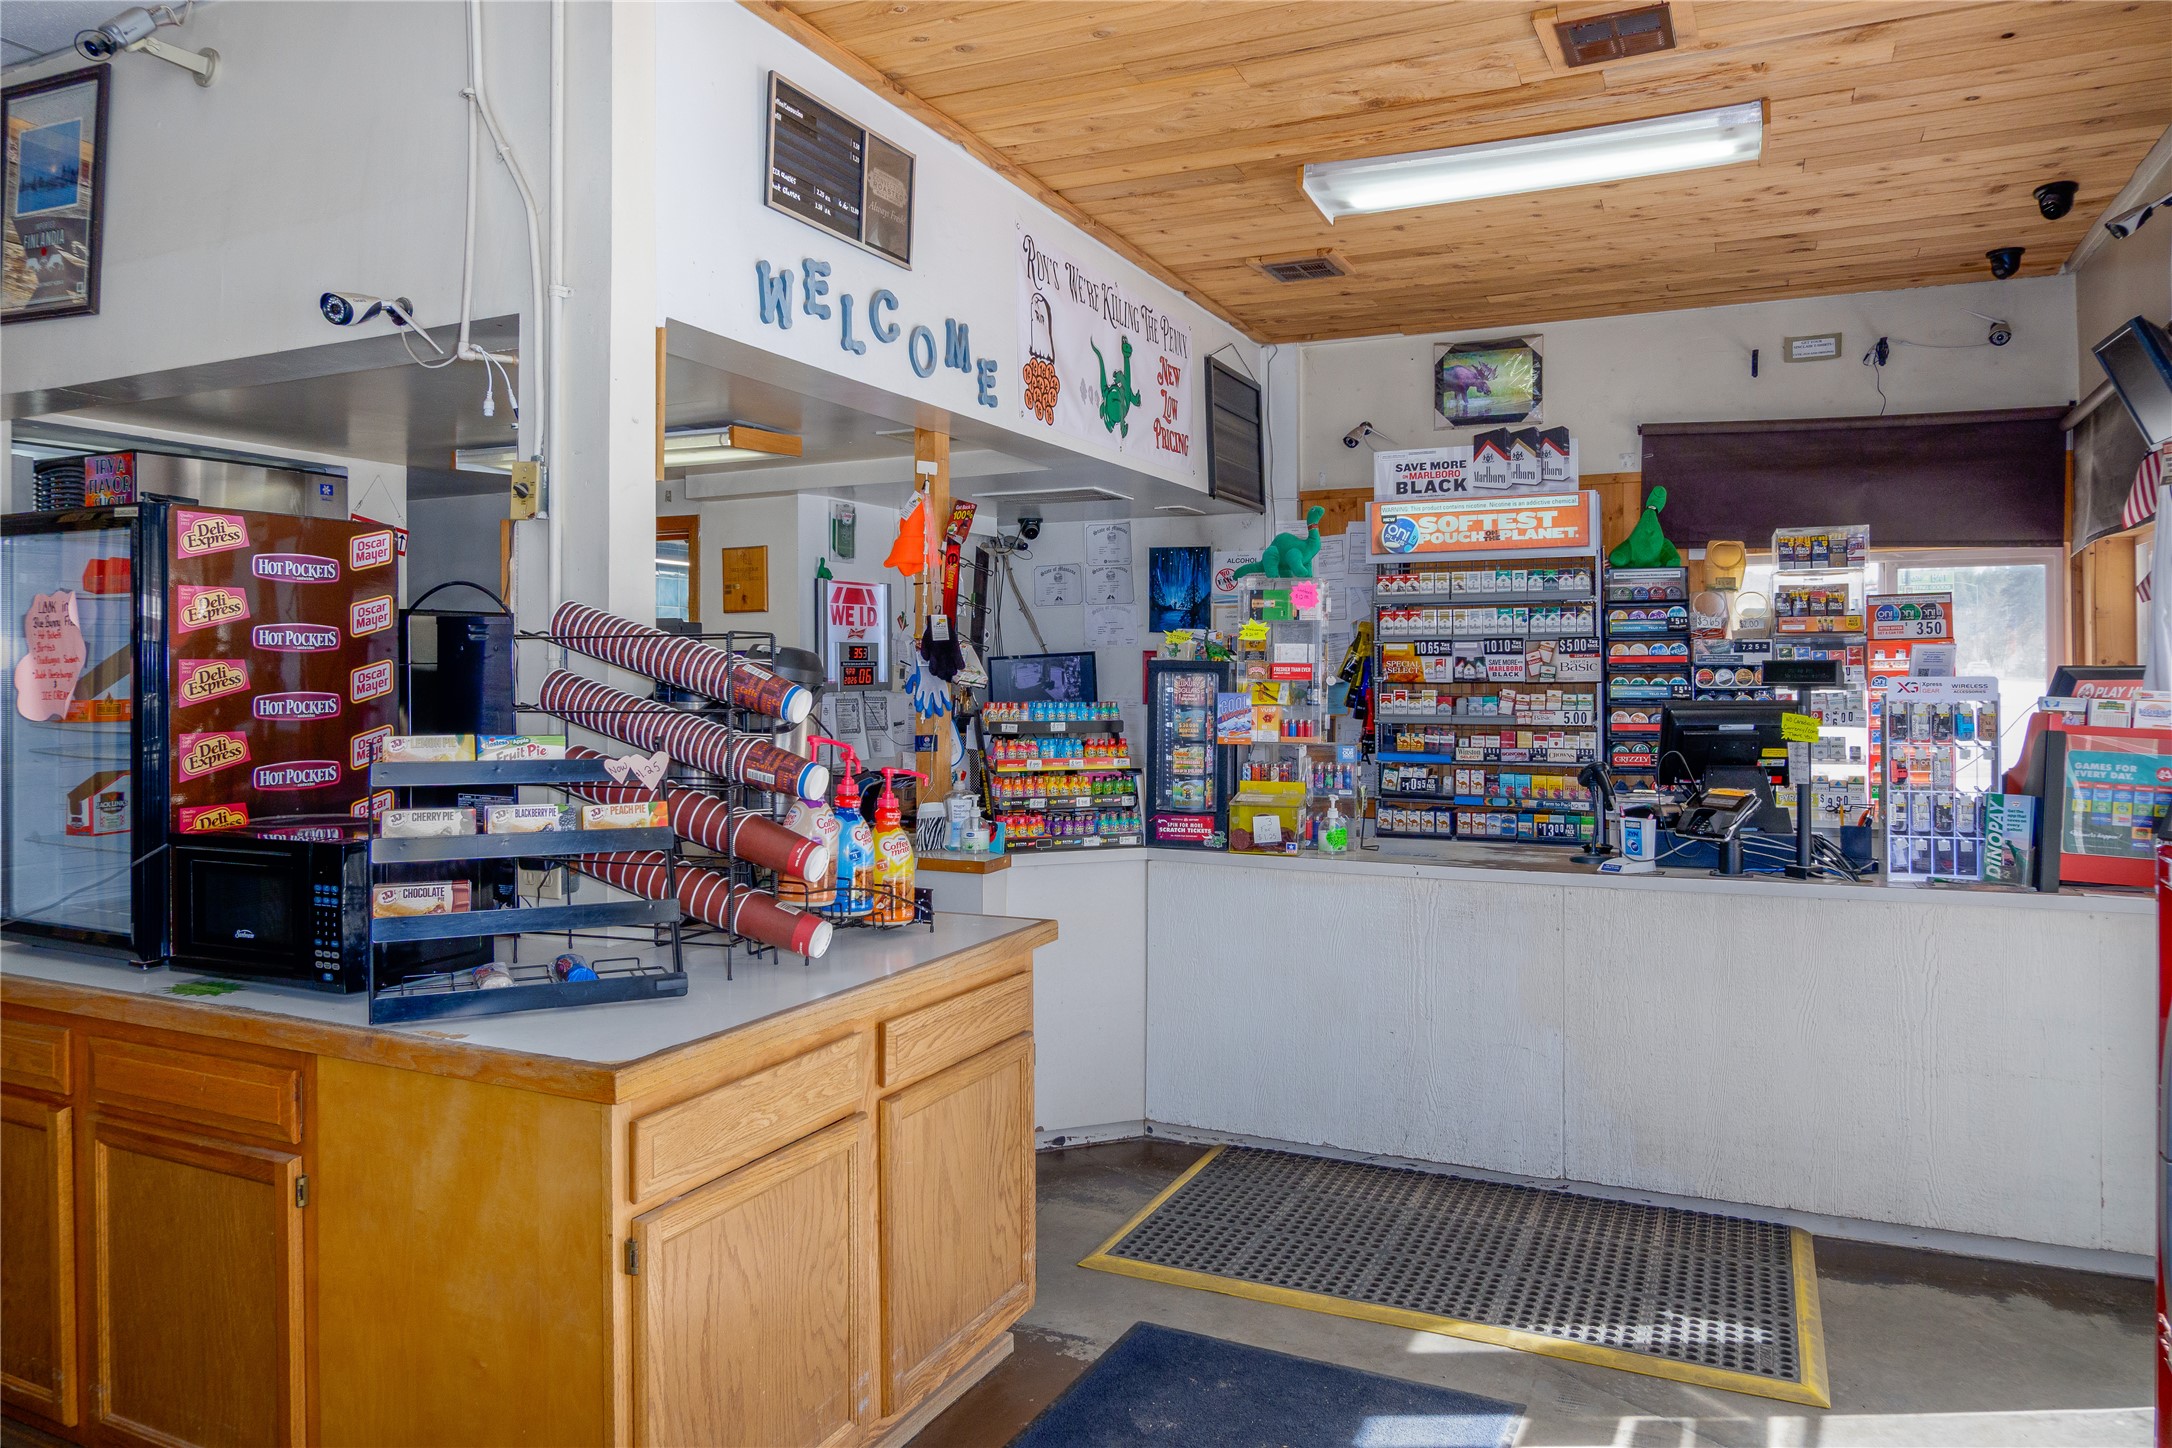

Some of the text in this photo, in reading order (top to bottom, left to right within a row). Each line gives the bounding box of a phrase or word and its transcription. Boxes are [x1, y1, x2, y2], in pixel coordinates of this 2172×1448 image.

[1023, 235, 1188, 359] ROY'S WE'RE KILLING THE PENNY
[756, 258, 998, 408] WELCOME
[1157, 356, 1181, 388] NEW
[1161, 389, 1178, 424] LOW
[1153, 418, 1189, 457] PRICING
[95, 456, 125, 475] TRY A
[1395, 460, 1467, 473] SAVE MORE
[1409, 469, 1461, 480] MARLBORO
[89, 475, 131, 495] FLAVOR
[1395, 477, 1468, 495] BLACK
[953, 510, 974, 520] 100%
[1418, 510, 1559, 533] SOFTEST
[197, 521, 225, 537] Deli
[1418, 526, 1579, 545] POUCH PLANET.
[187, 530, 242, 549] Express
[1385, 533, 1406, 546] PLUS
[355, 537, 390, 564] Oscar Mayer
[258, 559, 337, 578] HOT POCKETS
[197, 590, 226, 608] Deli
[187, 601, 242, 621] Express
[355, 603, 390, 631] Oscar Mayer
[830, 604, 879, 627] WE I.D.
[1916, 621, 1942, 635] 3.50
[258, 631, 337, 649] HOT POCKETS
[197, 662, 227, 681] Deli
[1387, 666, 1419, 674] SELECT
[1560, 661, 1598, 672] Basic
[187, 673, 242, 697] Express
[355, 668, 390, 695] Oscar Mayer
[859, 668, 872, 684] 06
[2094, 686, 2126, 698] PLAY
[258, 699, 337, 718] HOT POCKETS
[1220, 694, 1248, 714] COOL
[1563, 711, 1587, 725] 5.00
[197, 735, 228, 754] Deli
[410, 737, 457, 748] LEMON PIE
[482, 738, 510, 749] Hostess
[512, 737, 530, 746] Apple
[187, 745, 242, 770] Express
[496, 743, 548, 760] Fruit Pie
[1457, 748, 1481, 756] Winston
[1614, 755, 1649, 763] GRIZZLY
[2074, 762, 2138, 773] GAMES FOR
[2074, 769, 2134, 780] EVERY DAY.
[258, 769, 337, 789] HOT POCKETS
[411, 811, 454, 822] CHERRY PIE
[514, 807, 557, 818] BLACKBERRY PIE
[610, 803, 646, 815] PEACH PIE
[200, 811, 228, 828] Deli
[1266, 817, 1273, 826] 3
[882, 841, 909, 851] Coffee
[1985, 798, 2004, 880] DINOPAY
[402, 886, 445, 899] CHOCOLATE
